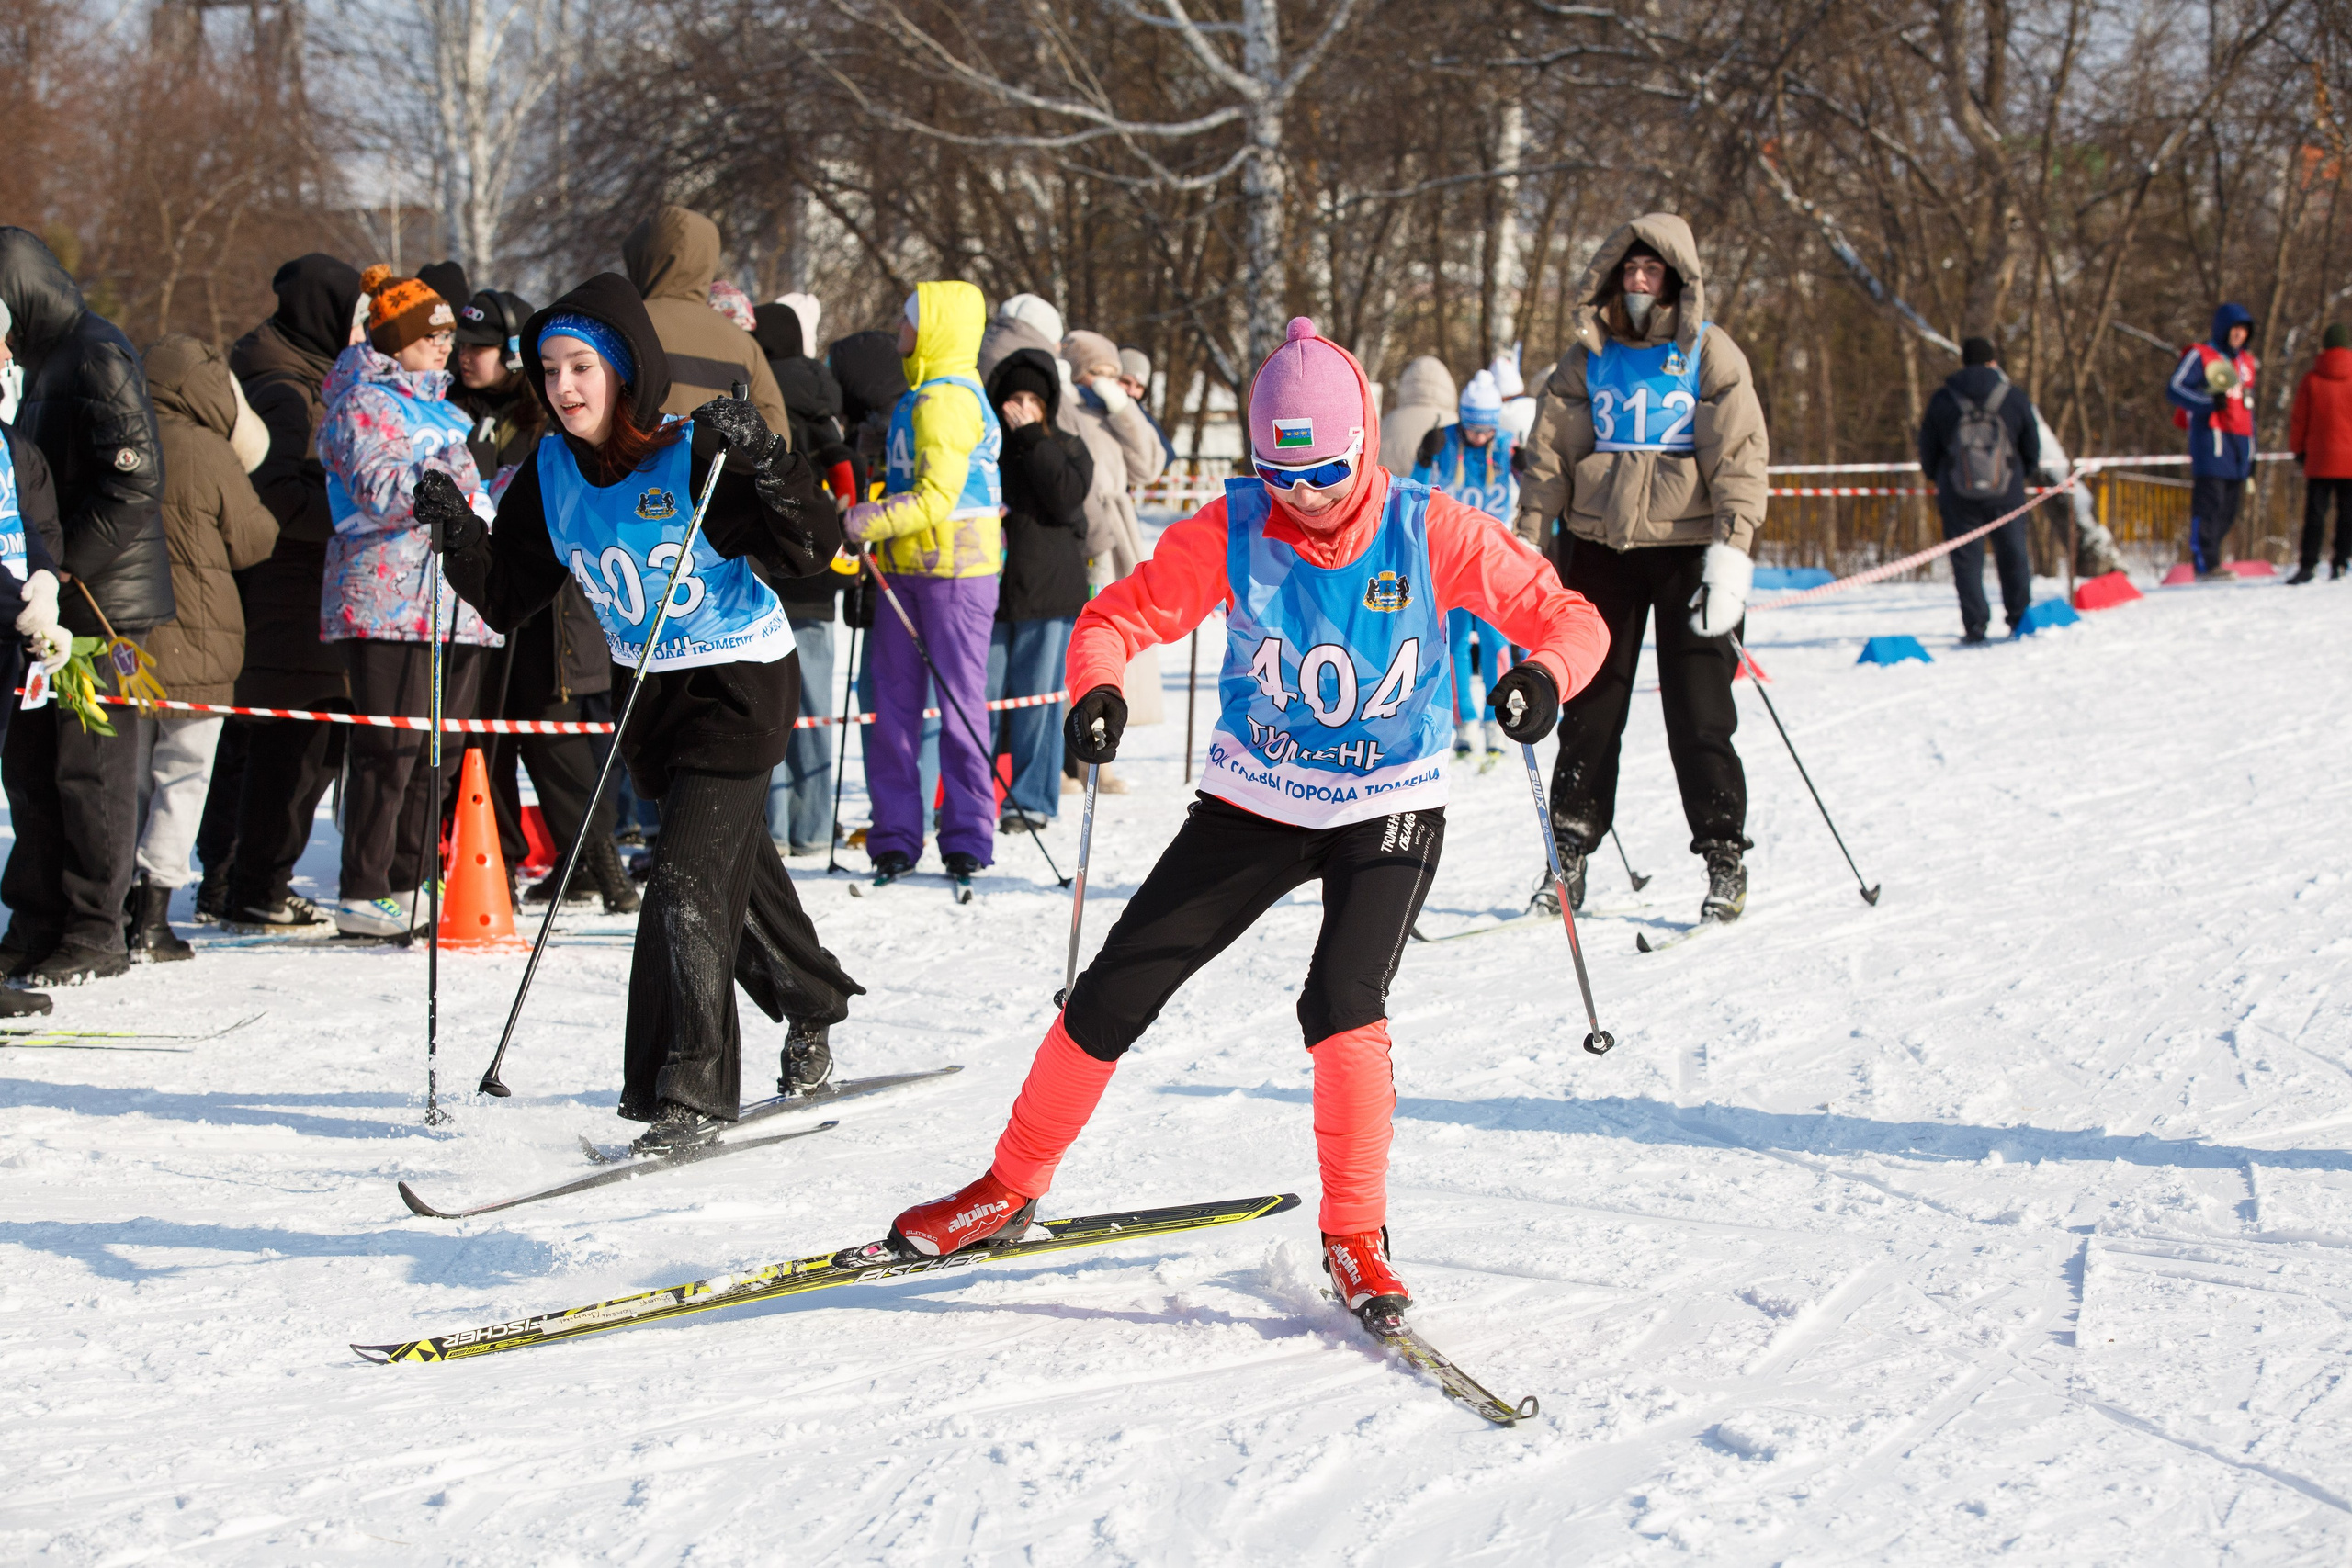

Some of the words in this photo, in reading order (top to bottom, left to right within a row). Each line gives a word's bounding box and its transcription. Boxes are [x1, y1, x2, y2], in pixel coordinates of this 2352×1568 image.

[1592, 388, 1696, 444] 312
[571, 541, 706, 627] 403
[1246, 635, 1419, 729] 404
[1284, 780, 1359, 805] ГОРОДА
[947, 1199, 1010, 1234] alpina
[854, 1251, 992, 1284] FISCHER
[1330, 1243, 1363, 1286] alpina
[441, 1314, 548, 1348] FISCHER
